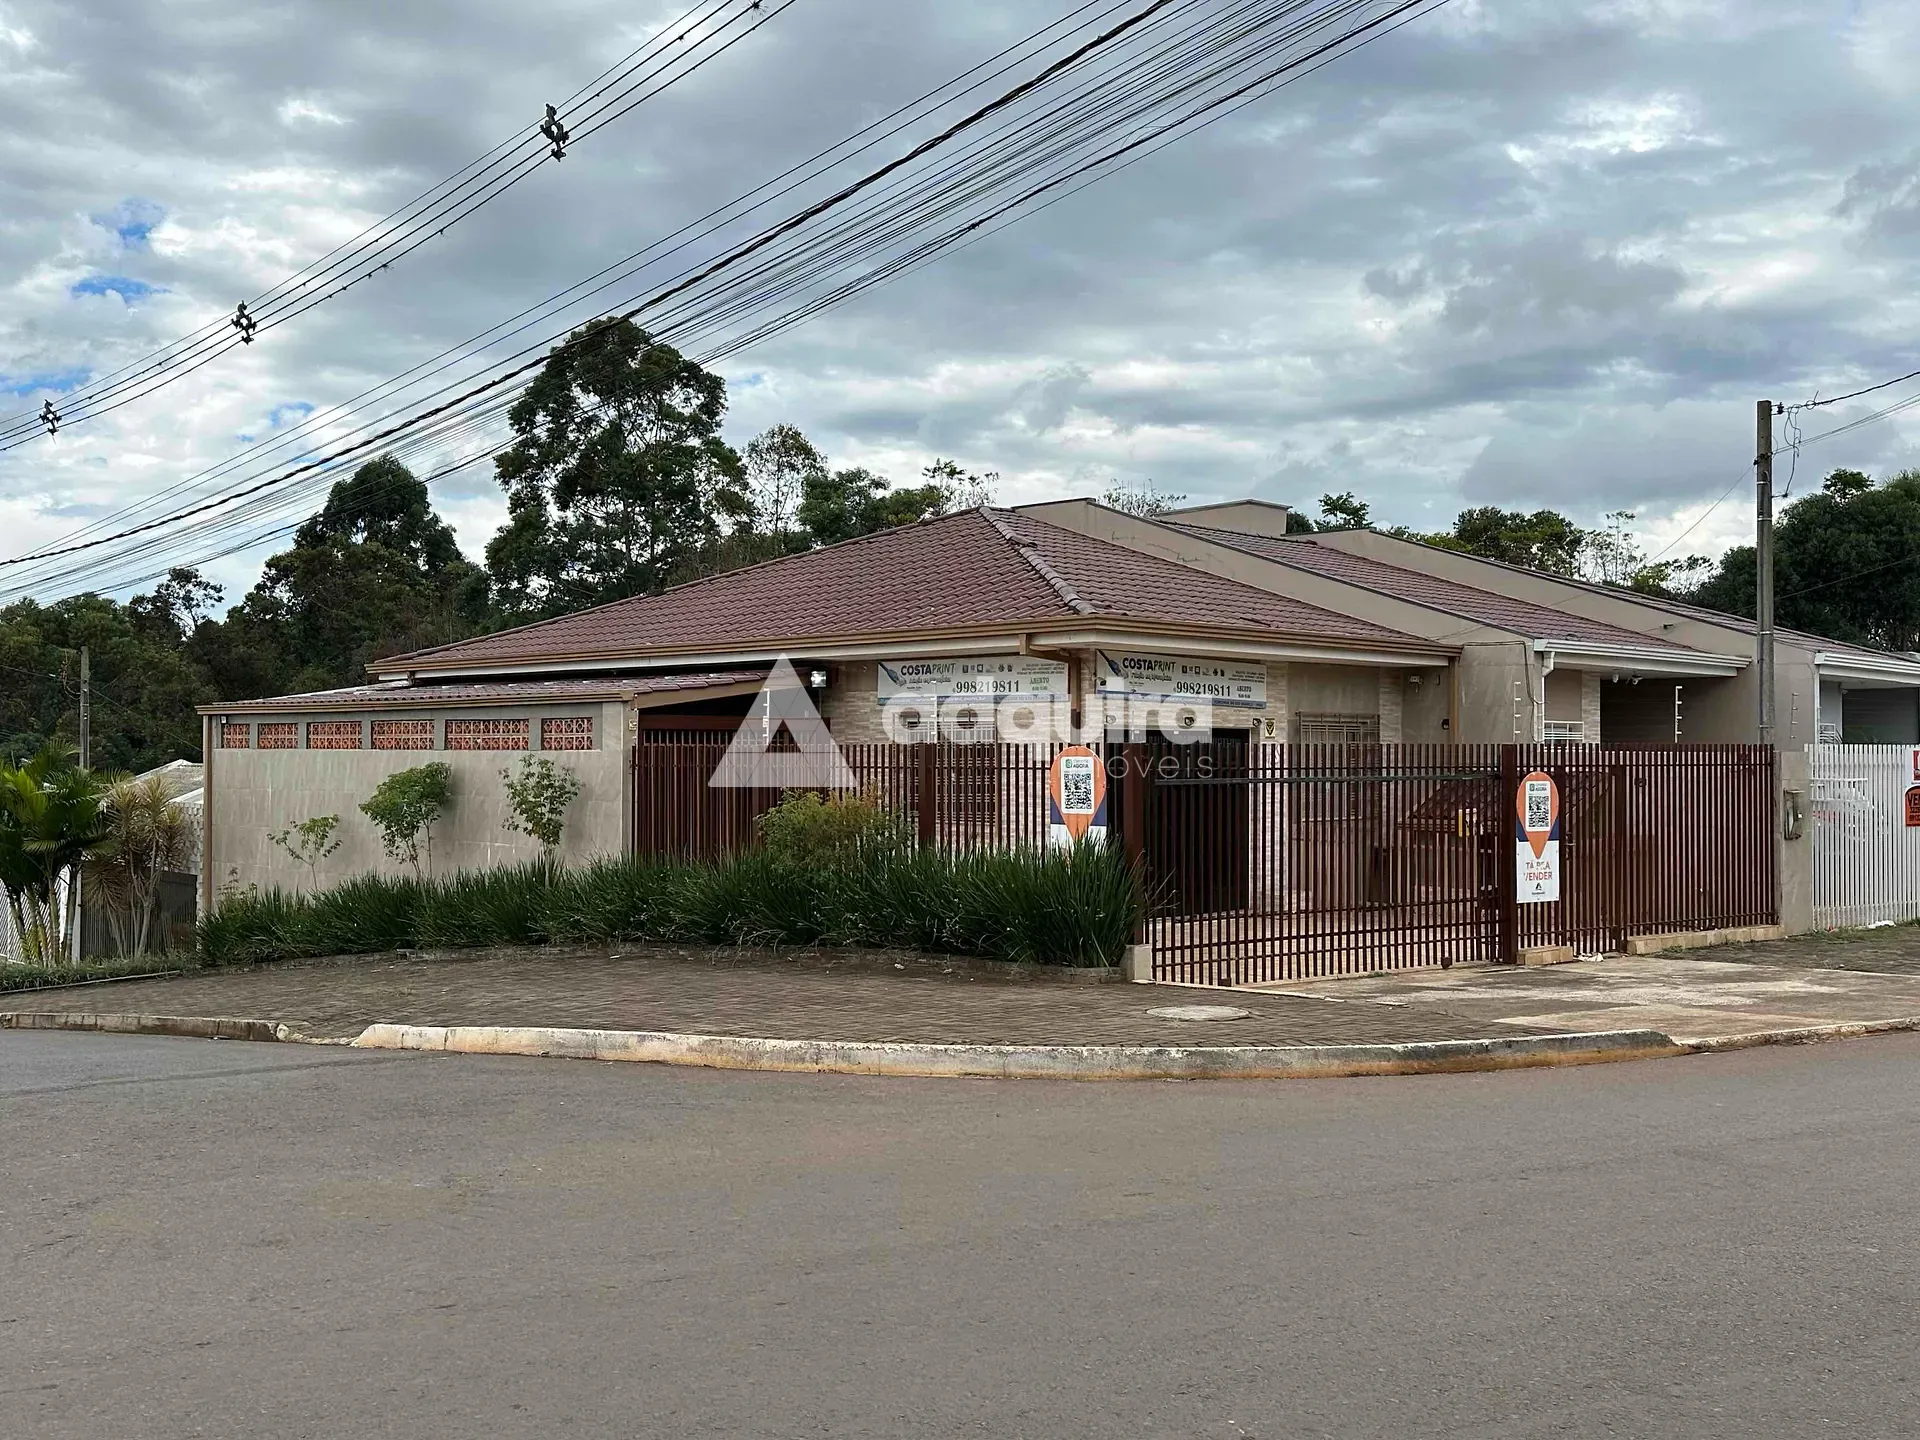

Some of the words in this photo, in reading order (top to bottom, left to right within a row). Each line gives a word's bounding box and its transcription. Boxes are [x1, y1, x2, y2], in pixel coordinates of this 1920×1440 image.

[900, 663, 956, 676] COSTAPRINT
[1122, 657, 1176, 673] COSTAPRINT
[956, 680, 1020, 693] 998219811
[1176, 681, 1231, 697] 998219811
